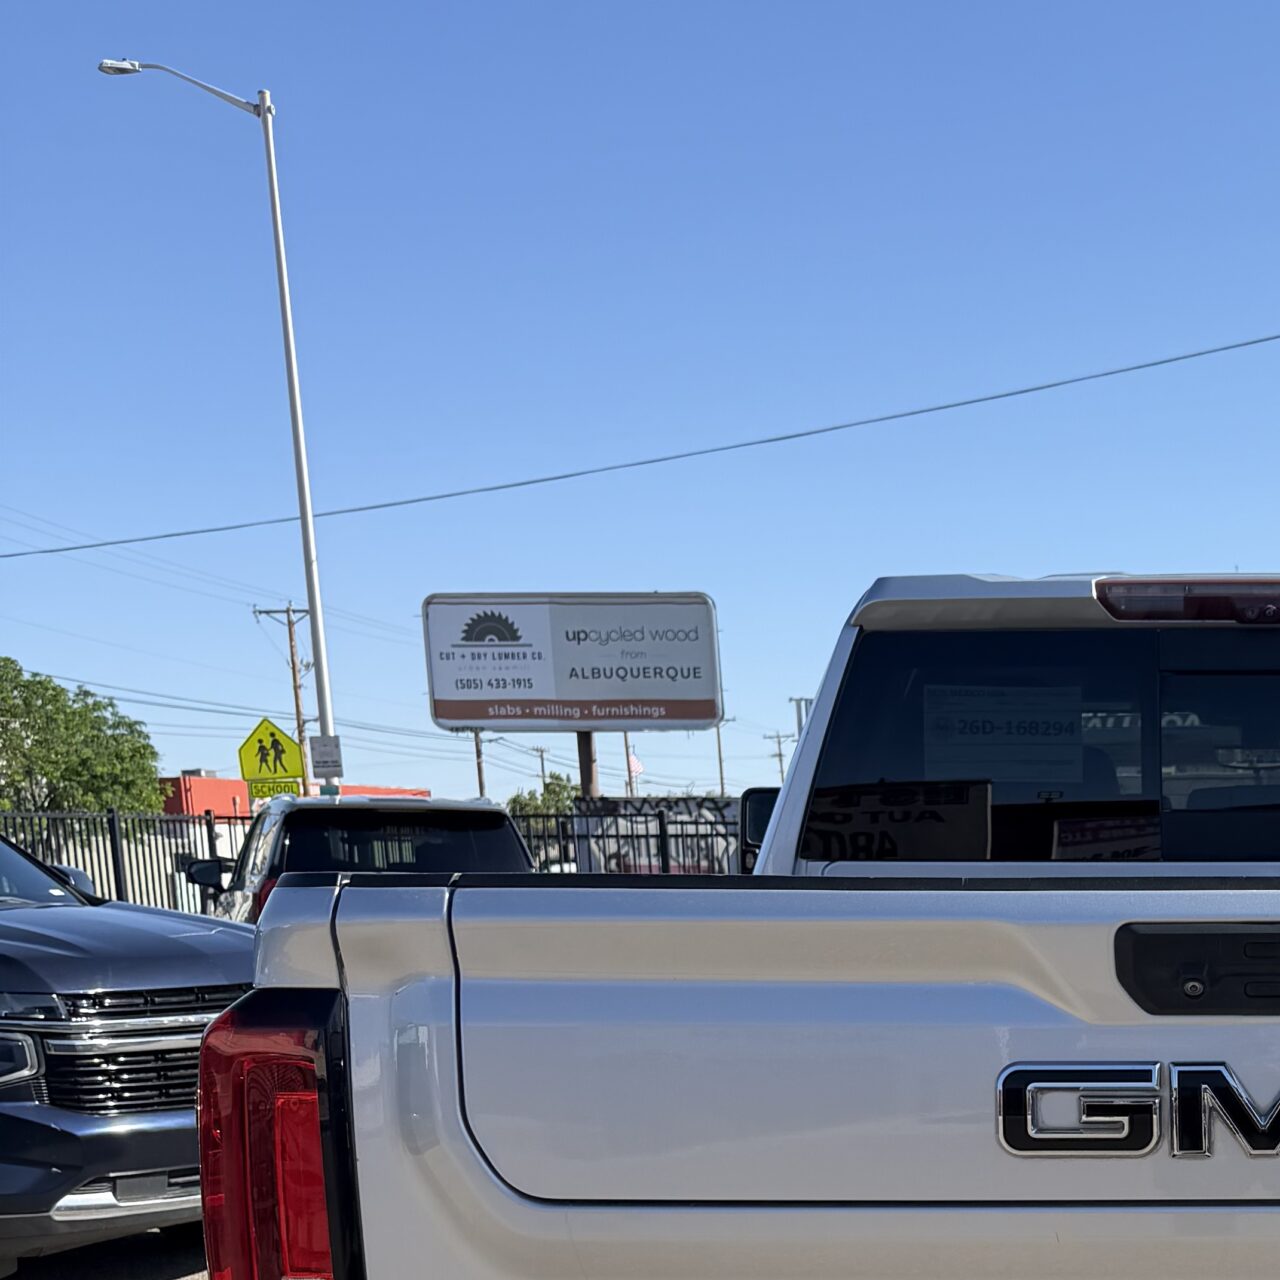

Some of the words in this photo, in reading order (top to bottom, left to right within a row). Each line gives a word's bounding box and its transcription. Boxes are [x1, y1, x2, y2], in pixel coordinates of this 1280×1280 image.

[565, 626, 645, 646] upcycled
[649, 626, 699, 642] wood
[439, 651, 456, 661] CUT
[471, 652, 488, 661] DRY
[492, 652, 528, 661] LUMBER
[620, 649, 647, 660] from
[569, 666, 703, 682] ALBUQUERQUE
[455, 677, 484, 691] (505)
[487, 677, 534, 690] 433-1915
[488, 704, 522, 716] slabs
[533, 704, 581, 718] milling
[591, 704, 667, 718] furnishings
[253, 784, 298, 795] SCHOOL
